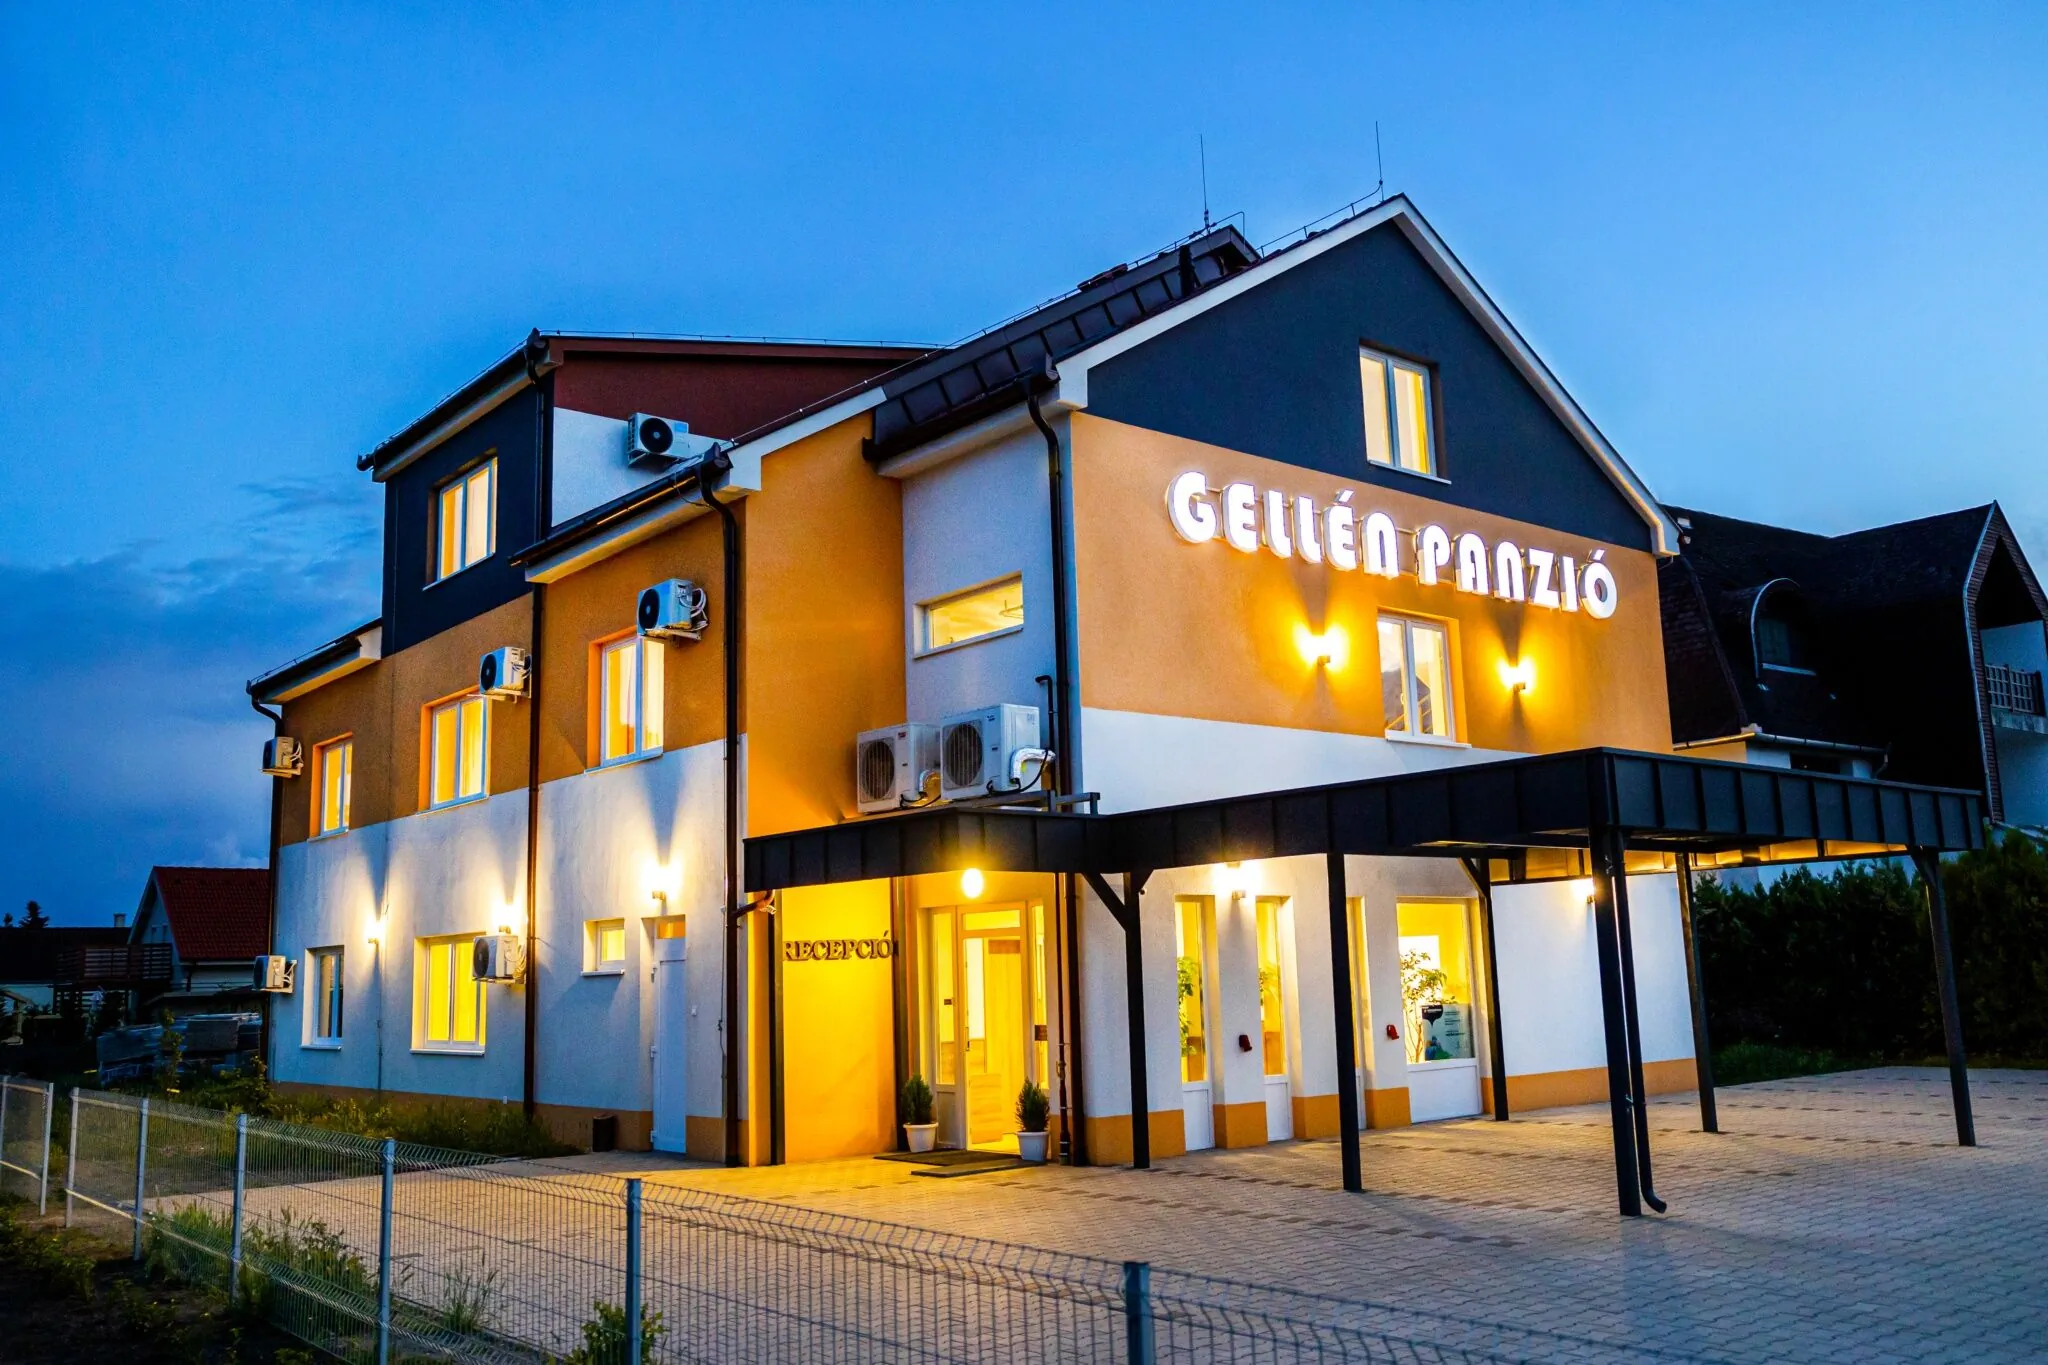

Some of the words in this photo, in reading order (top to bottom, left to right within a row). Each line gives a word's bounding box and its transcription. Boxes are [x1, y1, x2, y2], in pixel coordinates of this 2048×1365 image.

[1166, 471, 1400, 578] GELLÉN
[1417, 524, 1617, 619] PANZIÓ
[782, 930, 892, 961] RECEPCIÓ
